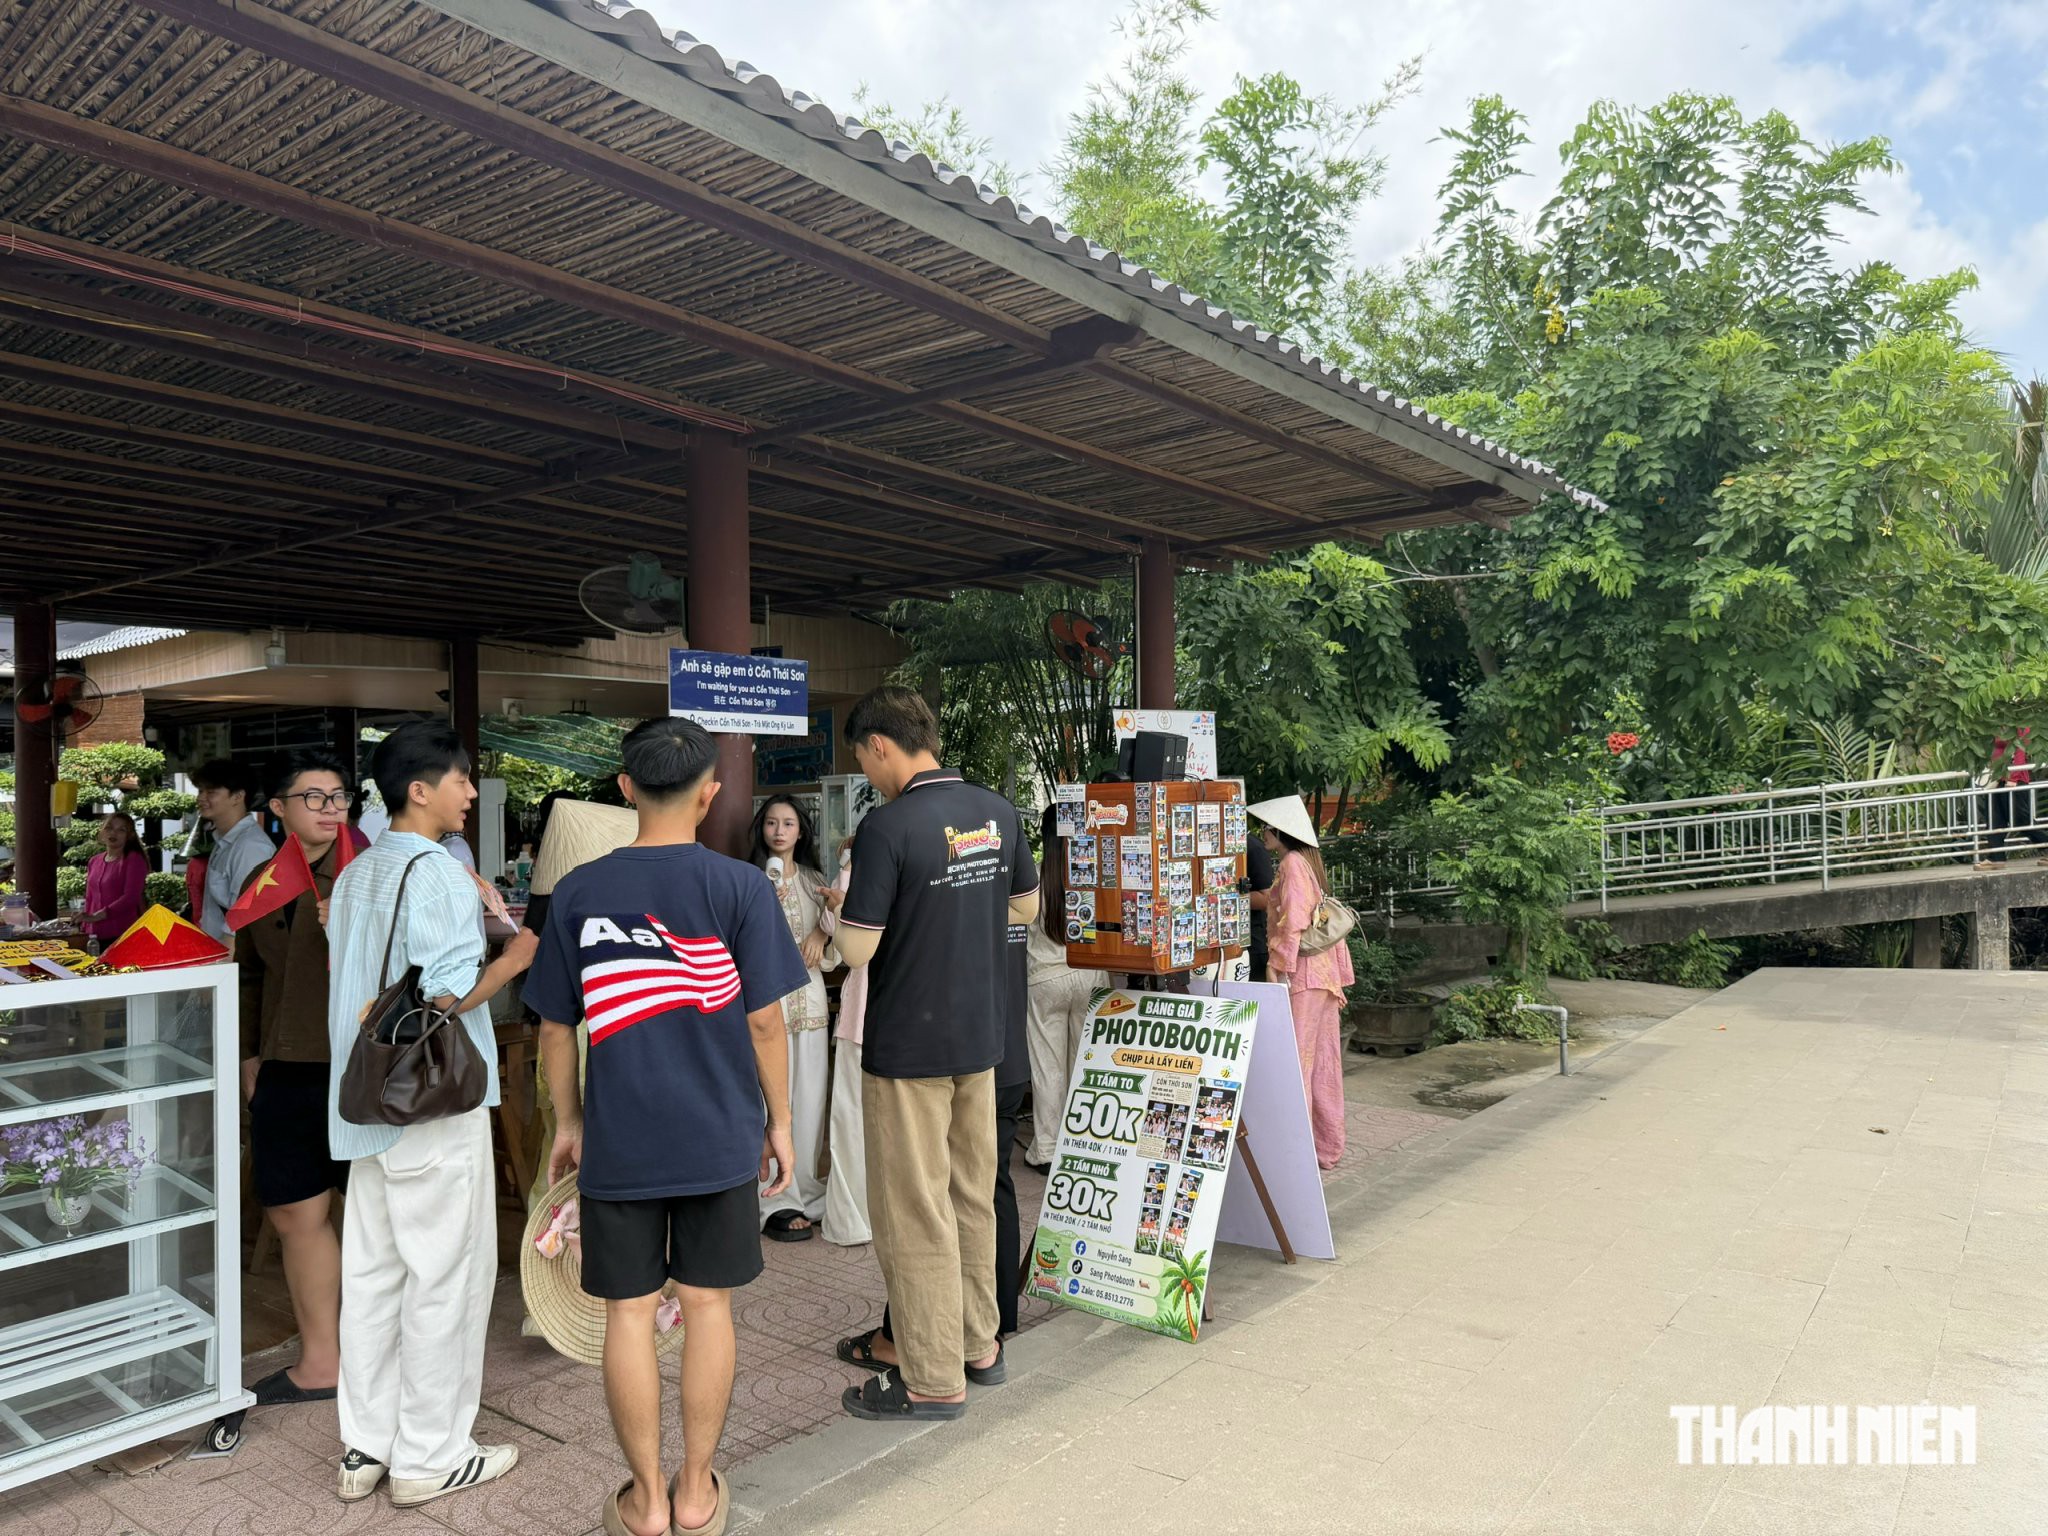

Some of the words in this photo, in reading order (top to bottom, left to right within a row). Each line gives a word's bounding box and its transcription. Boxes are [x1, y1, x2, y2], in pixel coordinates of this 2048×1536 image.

[680, 659, 700, 672] Anh
[701, 661, 712, 674] sẽ
[714, 662, 731, 678] gặp
[733, 666, 746, 676] em
[748, 664, 754, 677] ở
[755, 664, 771, 678] Cồn
[772, 667, 789, 680] Thới
[791, 669, 805, 682] Sơn
[697, 680, 707, 690] I'm
[708, 682, 728, 693] waiting
[729, 683, 737, 691] for
[738, 686, 748, 694] you
[750, 685, 755, 693] at
[697, 717, 718, 726] Checkin
[955, 828, 990, 852] SANG
[580, 918, 662, 948] Aa
[1145, 998, 1174, 1016] BẢNG
[1177, 1000, 1196, 1019] GIÁ
[1091, 1018, 1242, 1060] PHOTOBOOTH
[1121, 1053, 1142, 1065] CHỤP
[1144, 1054, 1154, 1065] LÀ
[1157, 1055, 1173, 1067] LẤY
[1090, 1074, 1094, 1084] 1
[1097, 1072, 1117, 1088] TẤM
[1121, 1078, 1133, 1090] TO
[1066, 1089, 1143, 1142] 50K
[1063, 1137, 1070, 1146] IN
[1071, 1138, 1088, 1149] THÊM
[1088, 1141, 1102, 1153] 40K
[1109, 1146, 1112, 1154] 1
[1064, 1158, 1071, 1169] 2
[1073, 1157, 1090, 1173] TẤM
[1091, 1162, 1110, 1176] NHỎ
[1048, 1173, 1118, 1221] 30K
[1065, 1216, 1076, 1225] 20K
[1118, 1254, 1132, 1267] Sang
[1090, 1268, 1103, 1280] Sang
[1104, 1271, 1135, 1287] Photobooth
[1081, 1285, 1095, 1296] Zalo:
[1096, 1290, 1134, 1307] 05.8513.2776
